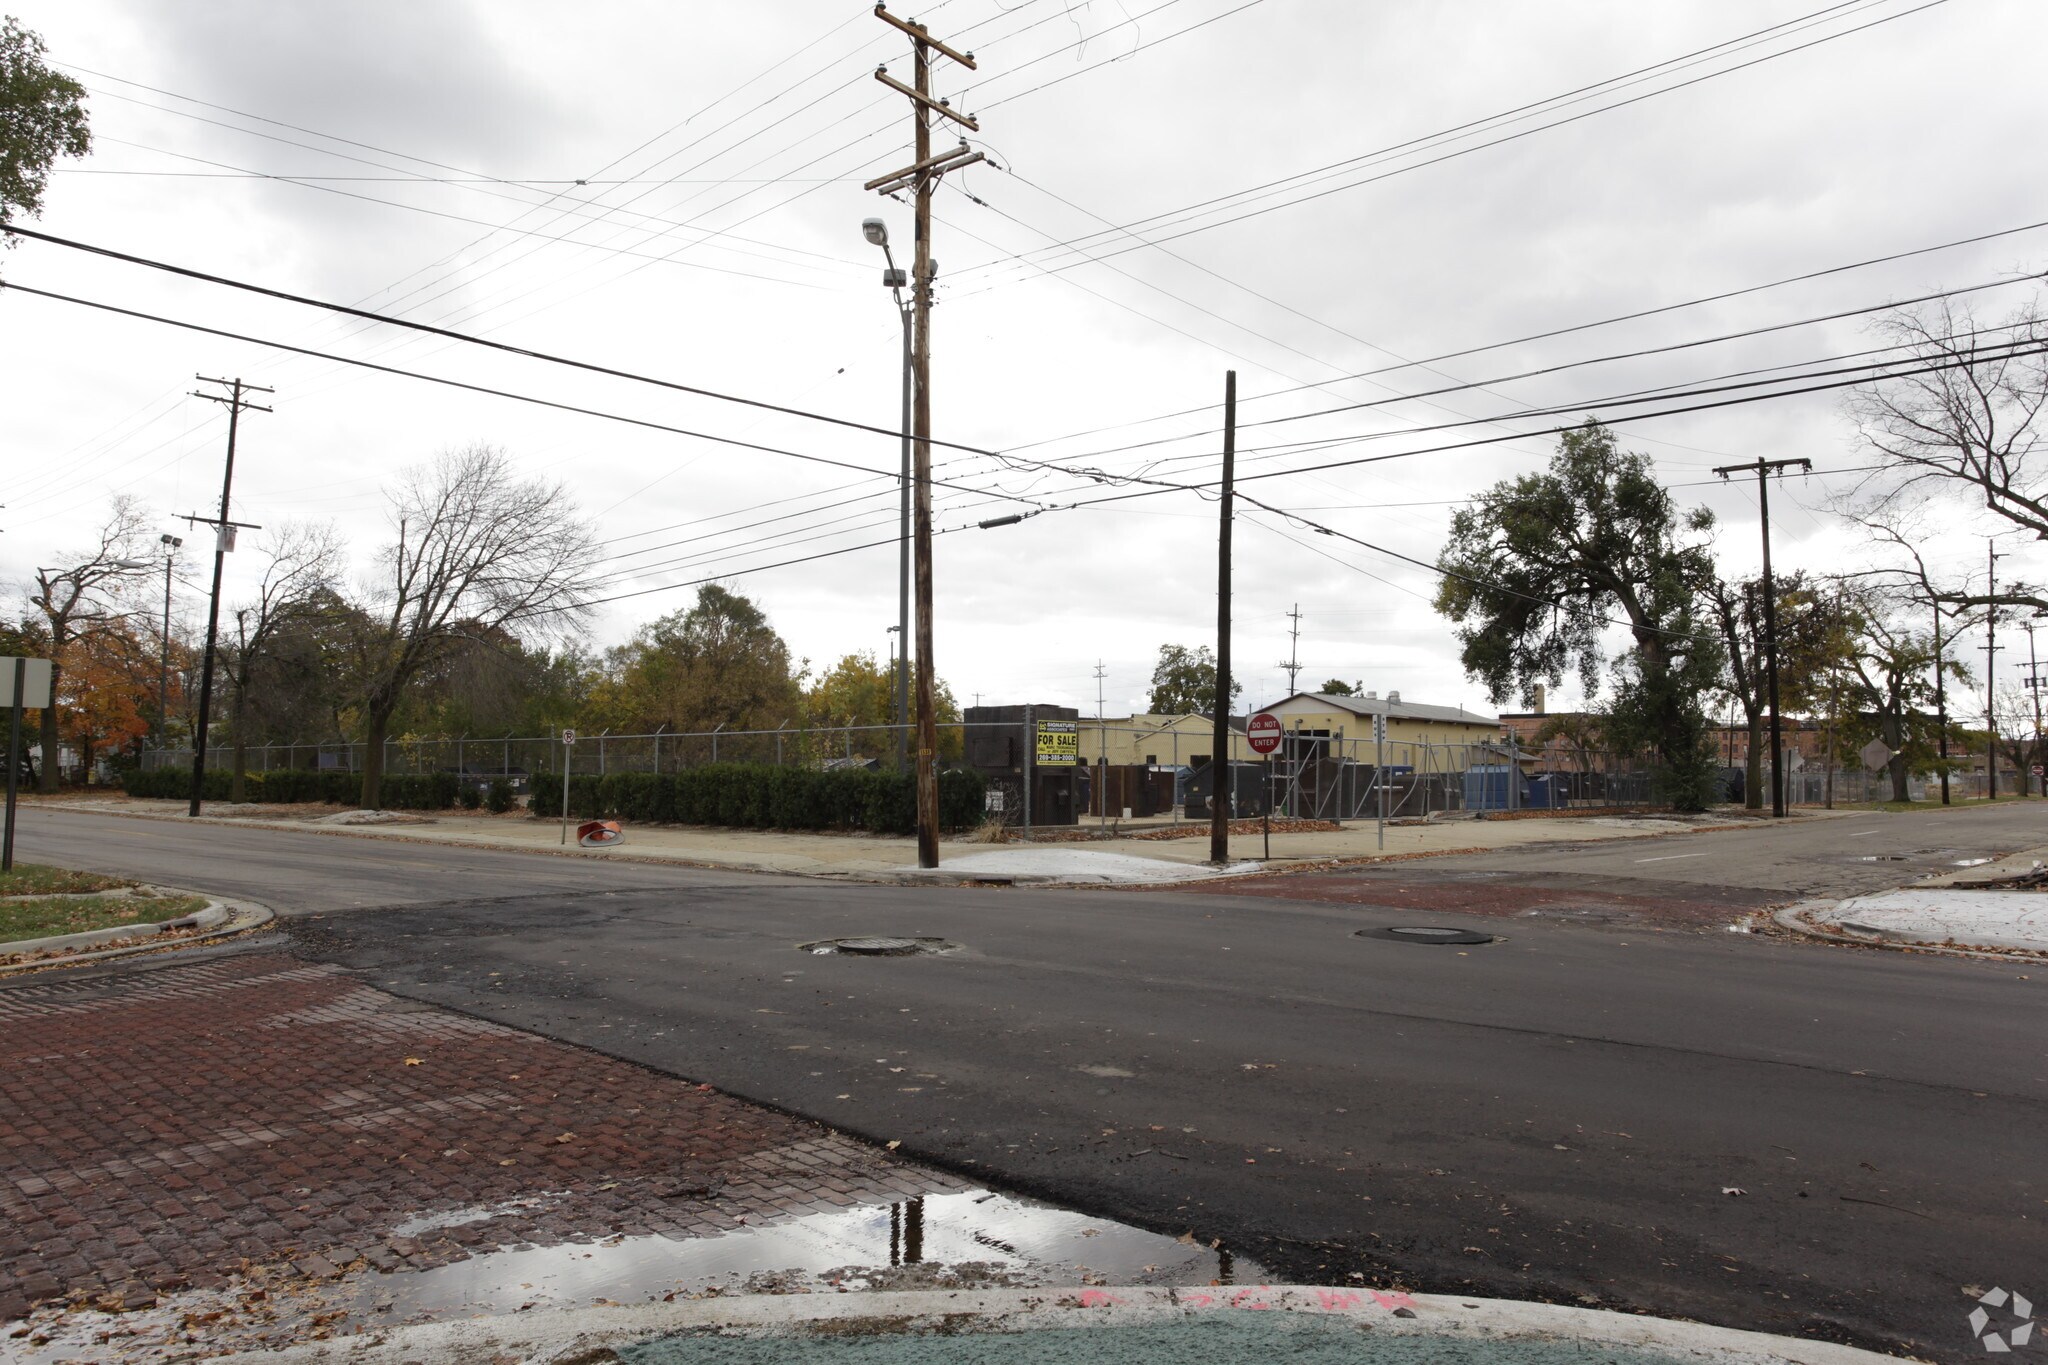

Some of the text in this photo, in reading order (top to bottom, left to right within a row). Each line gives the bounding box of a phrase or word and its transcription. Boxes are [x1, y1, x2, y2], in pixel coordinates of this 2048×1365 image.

[1038, 735, 1076, 745] FOR SALE
[1254, 739, 1274, 747] ENTER
